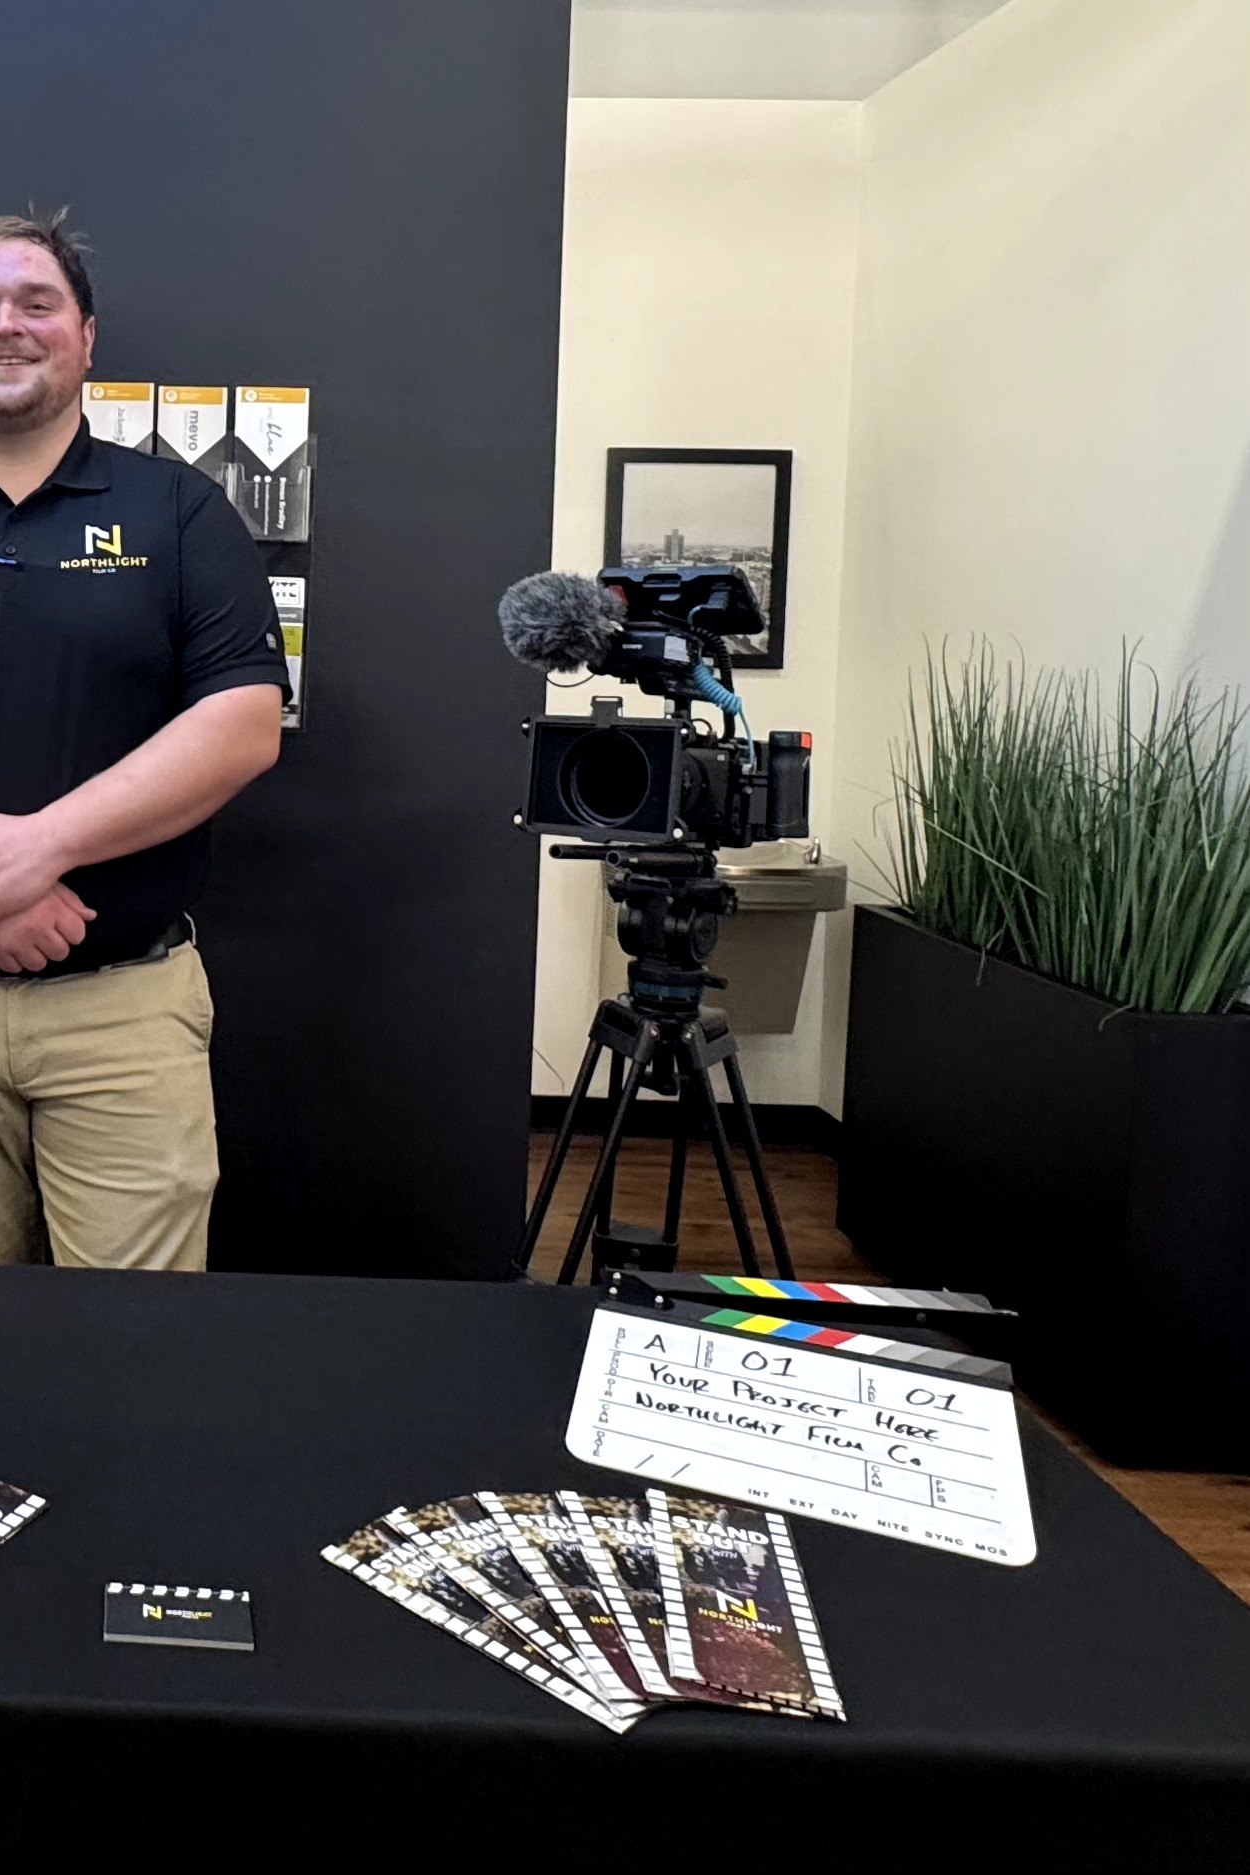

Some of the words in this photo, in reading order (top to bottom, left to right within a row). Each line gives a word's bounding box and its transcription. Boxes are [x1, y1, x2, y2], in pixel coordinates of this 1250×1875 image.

[187, 409, 199, 452] mevo
[60, 556, 148, 569] NORTHLIGHT
[644, 1334, 666, 1353] A
[672, 1515, 770, 1545] STAND
[748, 1488, 770, 1499] INT
[789, 1498, 815, 1510] EXT
[831, 1508, 858, 1520] DAY
[877, 1519, 910, 1533] NITE
[925, 1530, 965, 1546] SYNC
[974, 1543, 1008, 1557] MOS
[692, 1531, 754, 1554] OUT
[711, 1548, 738, 1559] WITH
[698, 1607, 783, 1634] NORTHLIGHT
